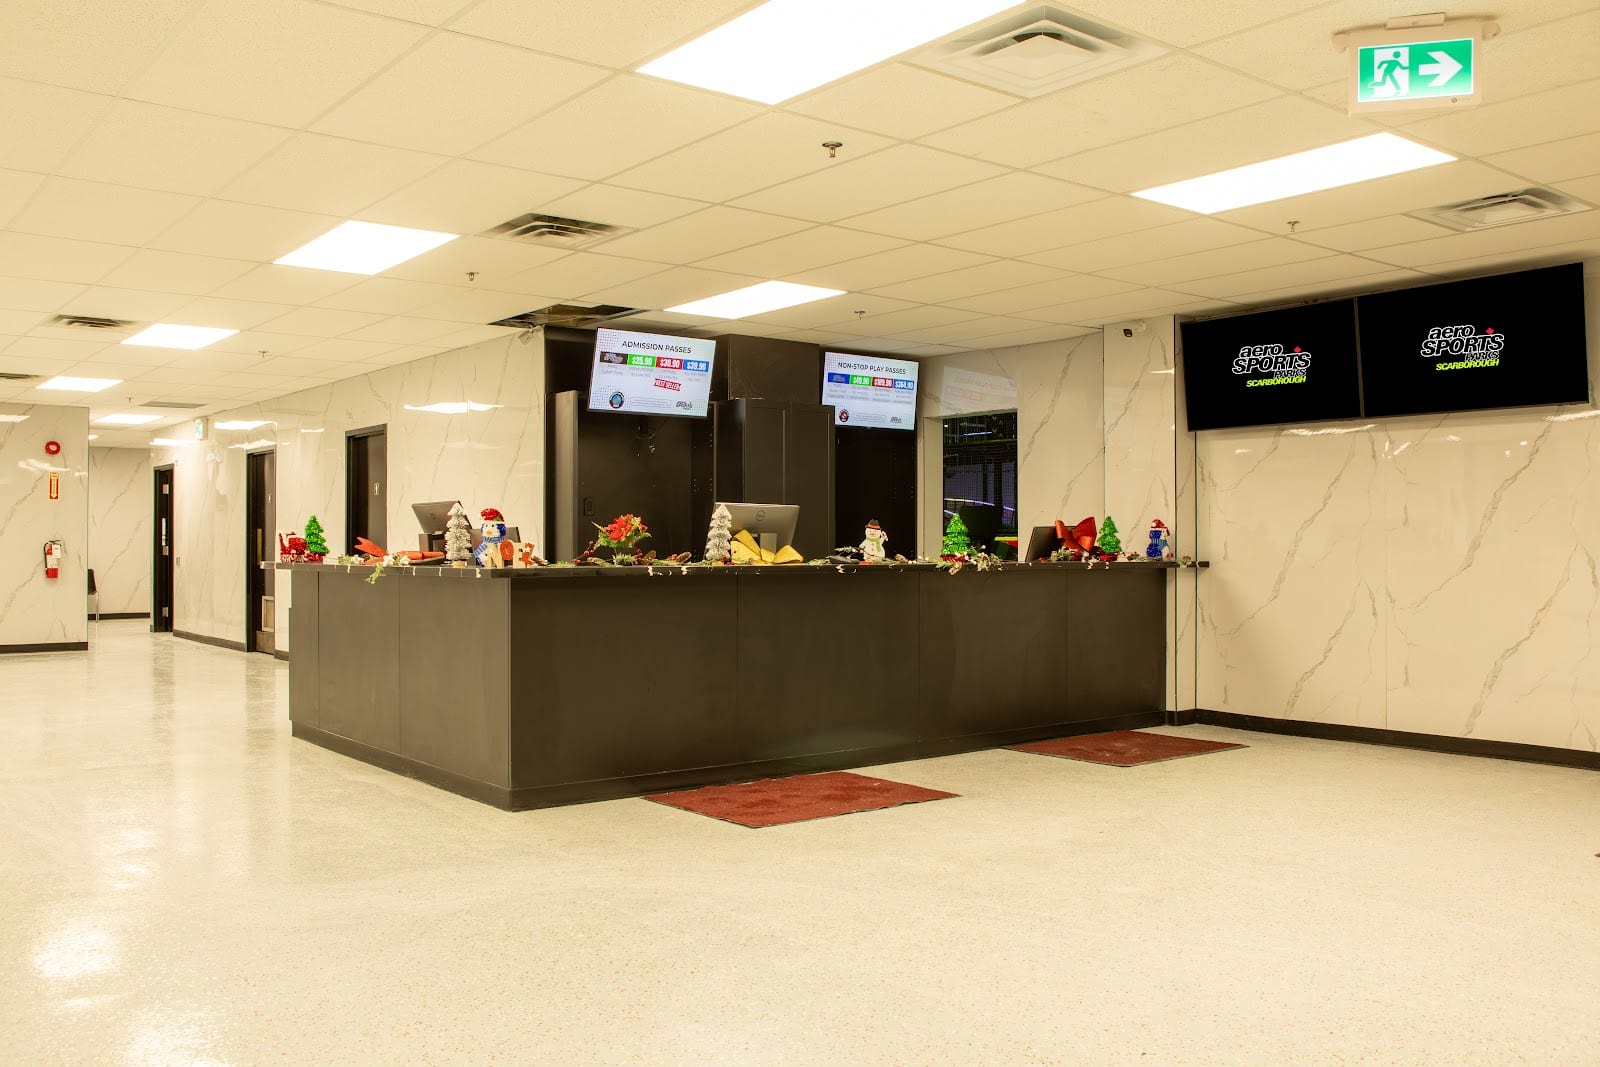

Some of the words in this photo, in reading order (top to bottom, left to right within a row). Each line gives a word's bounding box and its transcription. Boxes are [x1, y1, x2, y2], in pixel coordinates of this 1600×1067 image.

[1428, 325, 1475, 341] aero
[621, 340, 664, 351] ADMISSION
[665, 344, 692, 354] PASSES
[1239, 344, 1283, 358] aero
[1421, 333, 1504, 357] SPORTS
[659, 359, 680, 369] $30.90
[838, 362, 868, 370] NON-STOP
[885, 367, 907, 375] PASSES
[1232, 352, 1311, 374] SPORTS
[1435, 358, 1500, 371] SCARBOROUGH
[1246, 375, 1307, 387] SCARBOROUGH
